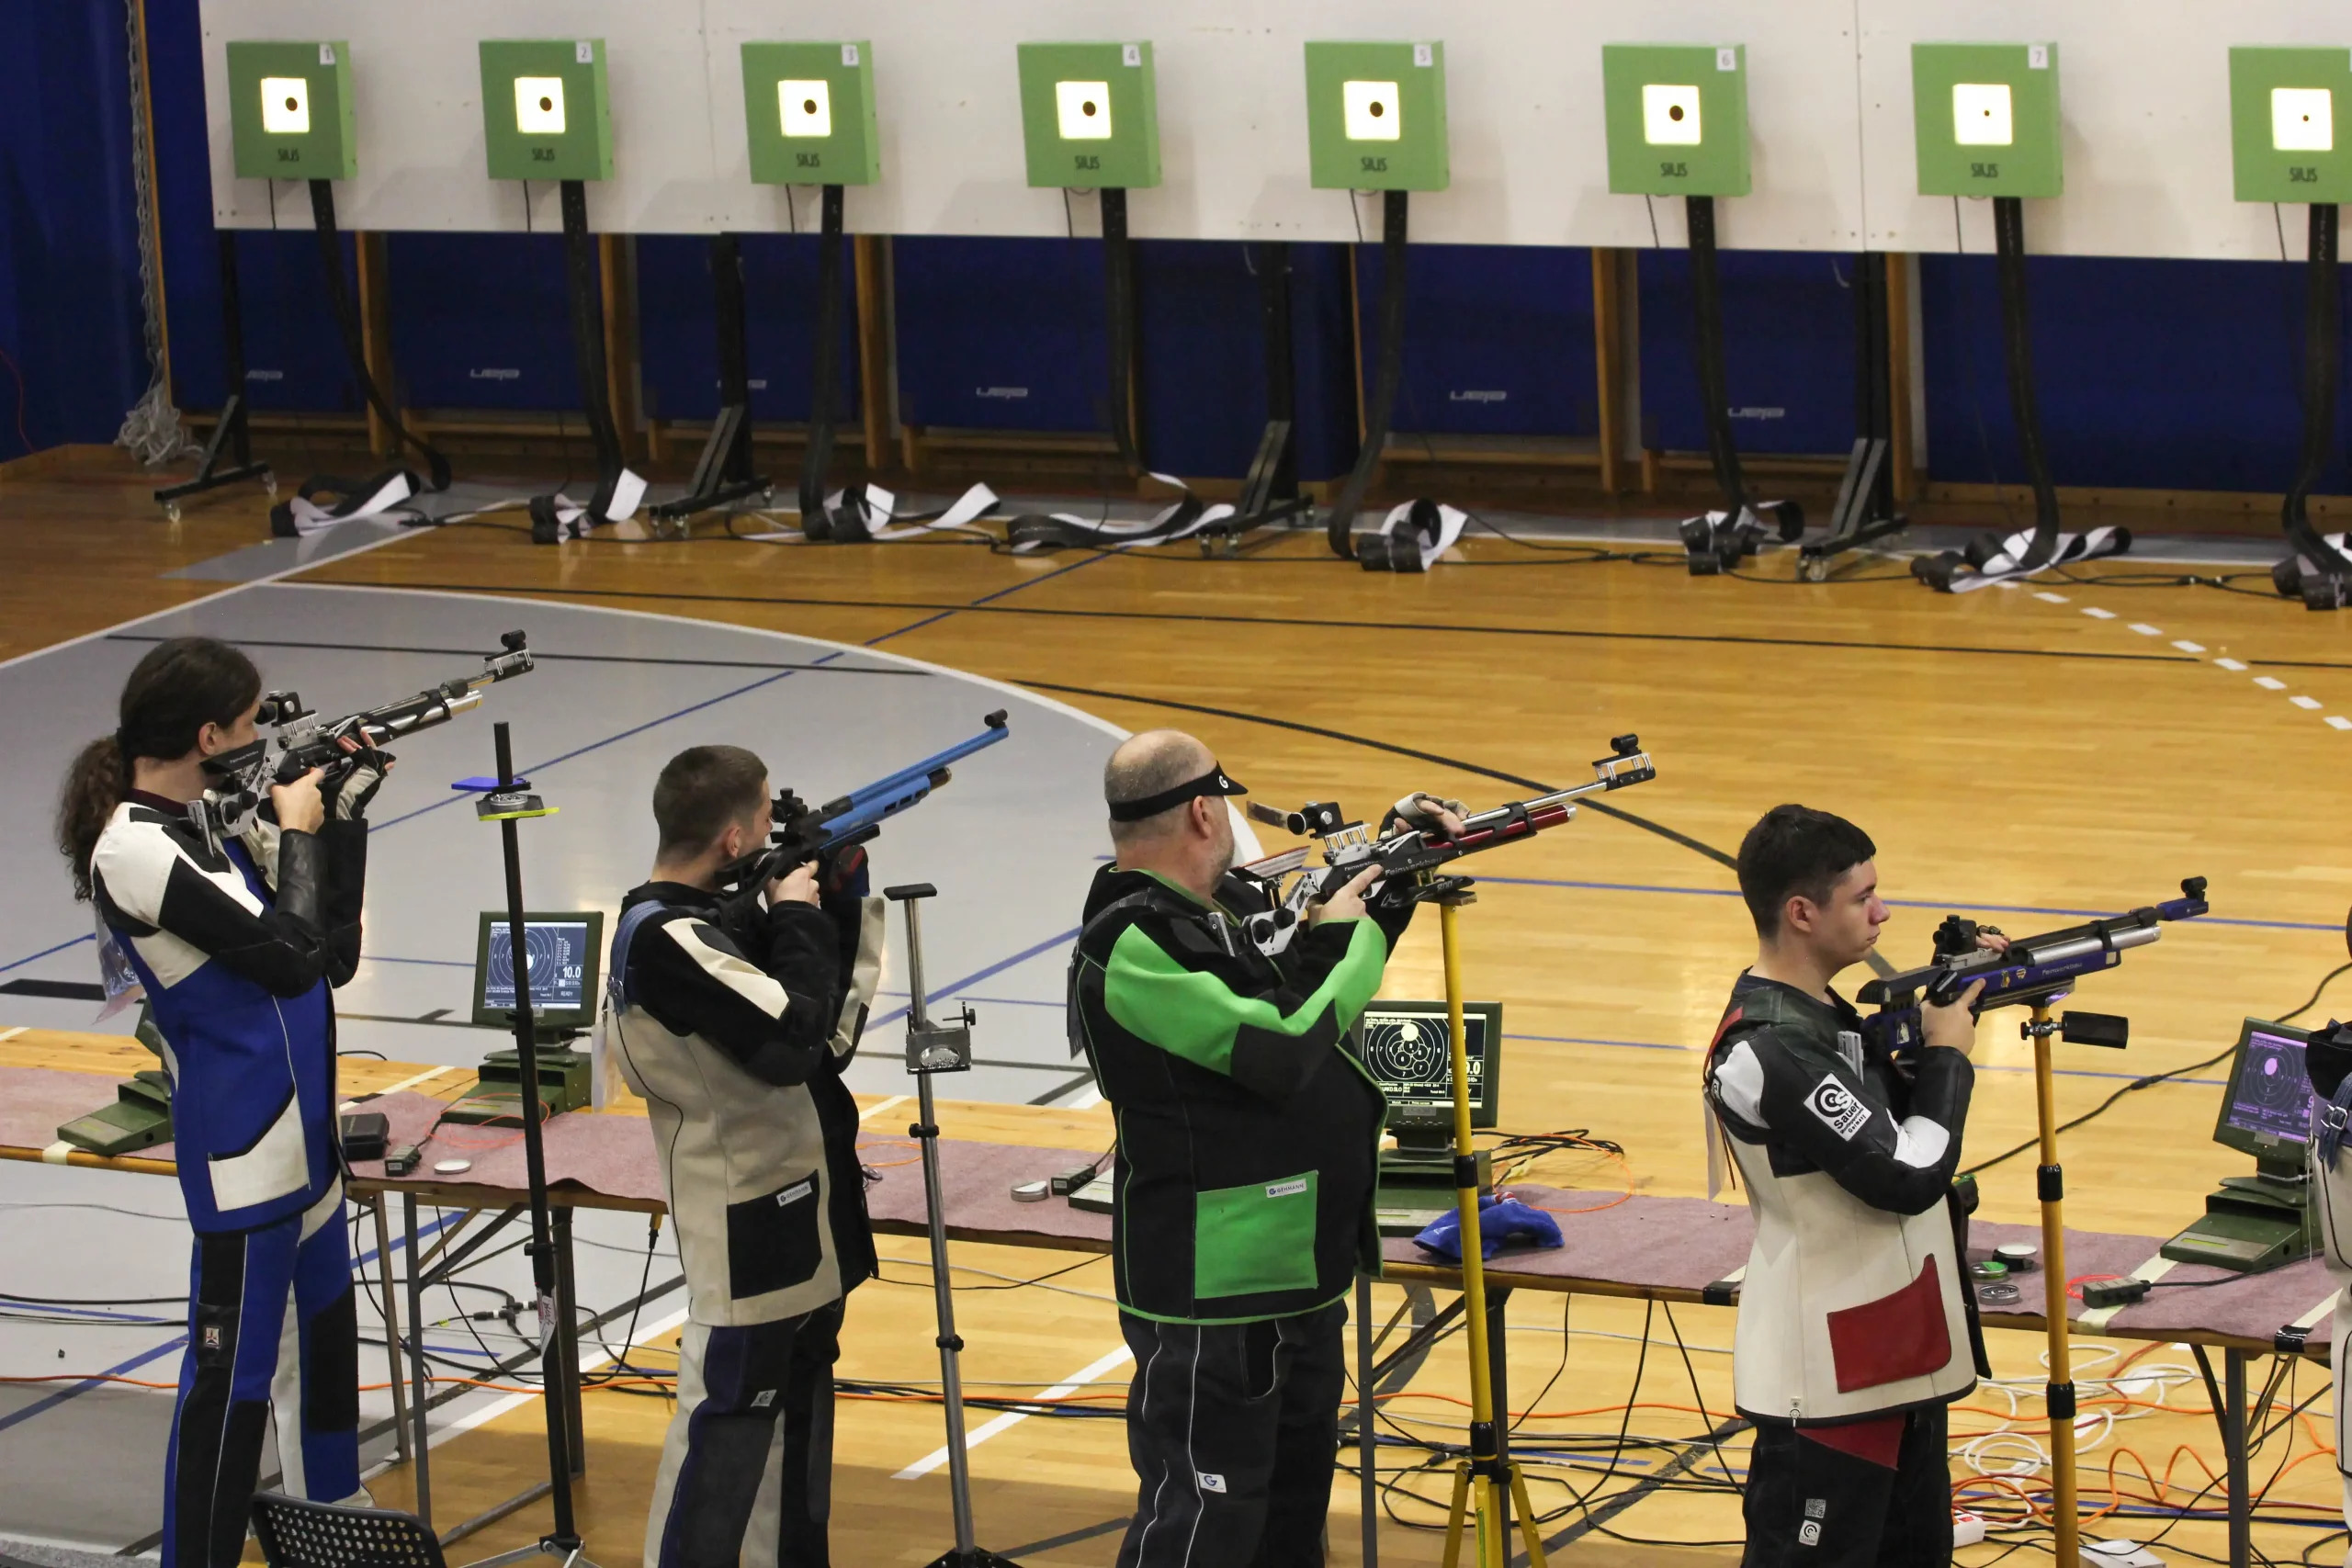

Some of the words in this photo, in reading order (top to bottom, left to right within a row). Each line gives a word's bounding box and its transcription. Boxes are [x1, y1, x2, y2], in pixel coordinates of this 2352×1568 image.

[1385, 856, 1443, 876] Feinwerkbau
[562, 965, 582, 979] 10.0
[1833, 1101, 1860, 1130] Sauer
[1848, 1114, 1867, 1134] Germany
